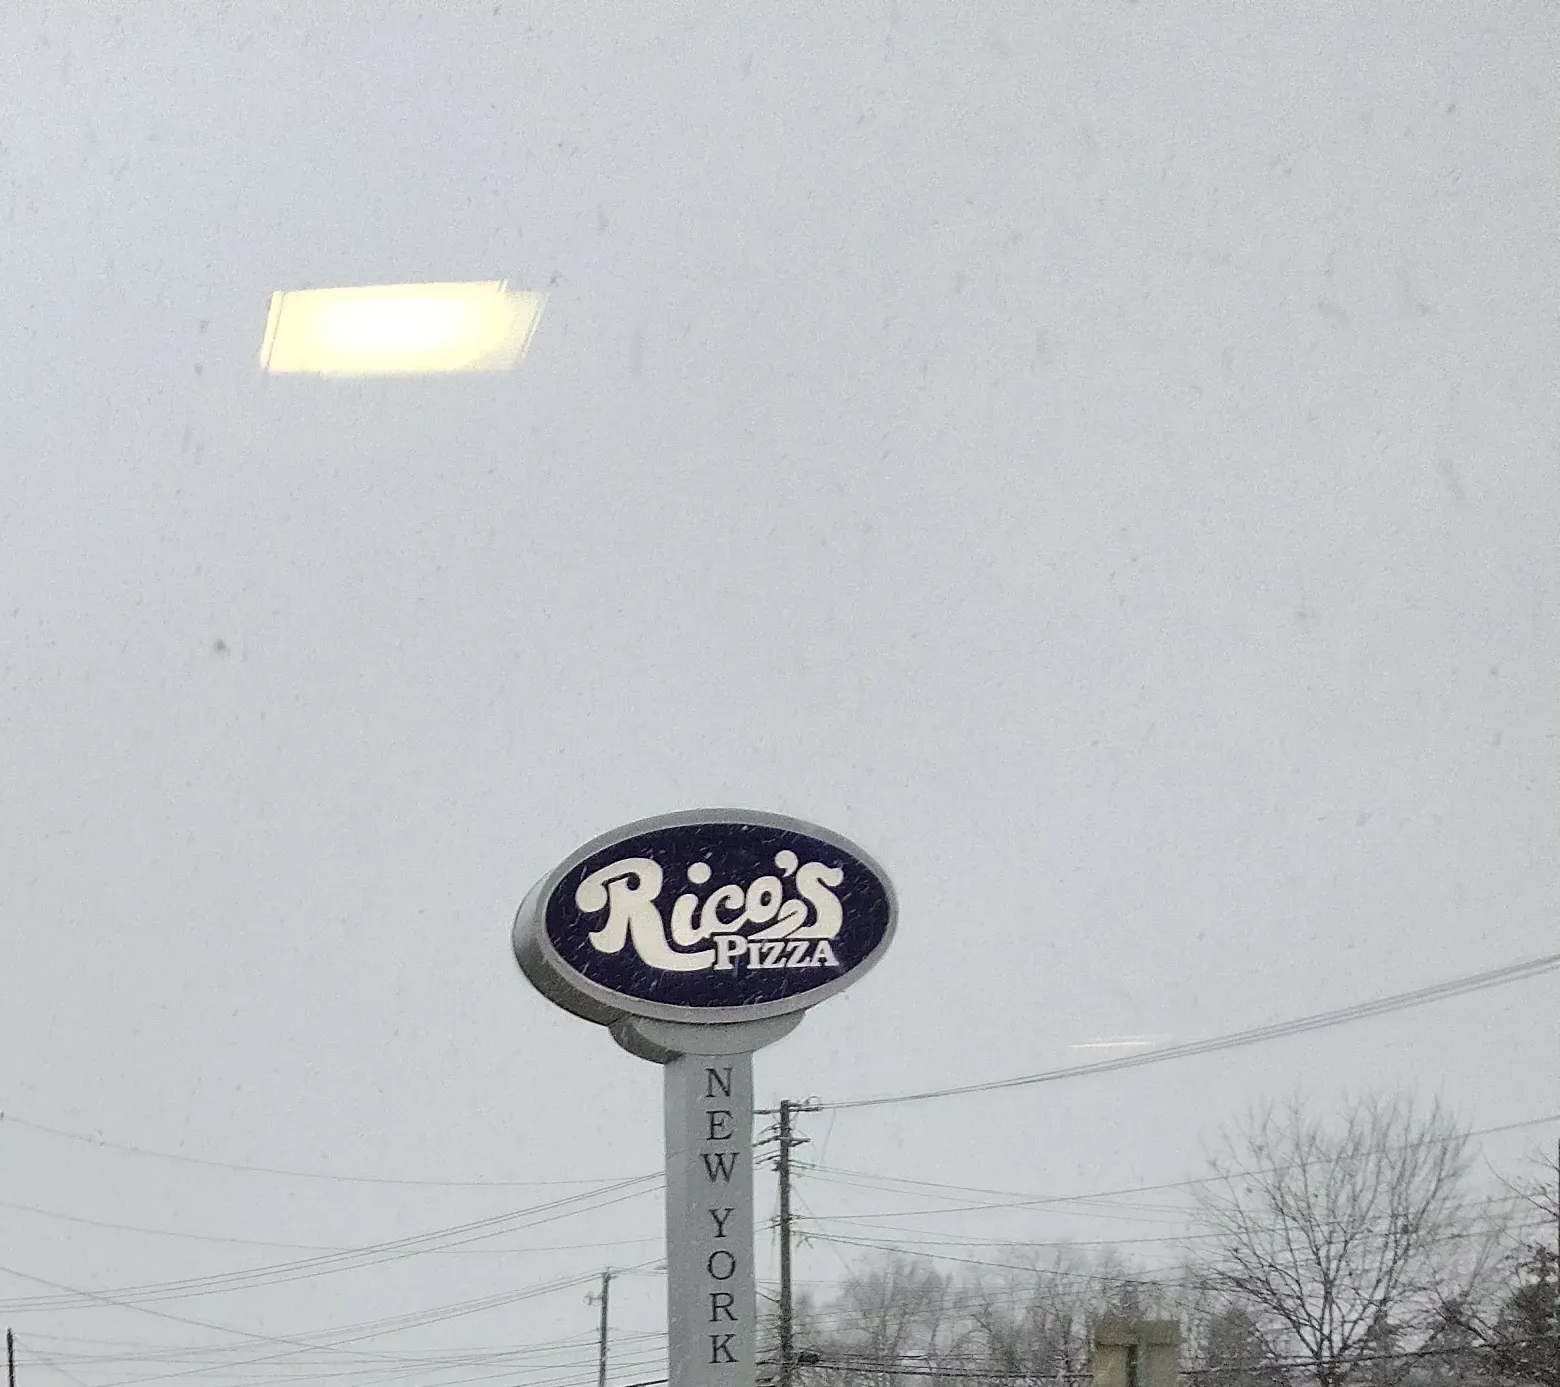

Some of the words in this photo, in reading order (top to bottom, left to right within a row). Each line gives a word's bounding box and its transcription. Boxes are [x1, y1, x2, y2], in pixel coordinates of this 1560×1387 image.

[713, 932, 840, 971] PIZZA
[700, 1067, 741, 1183] NEW
[706, 1207, 740, 1364] YORK
